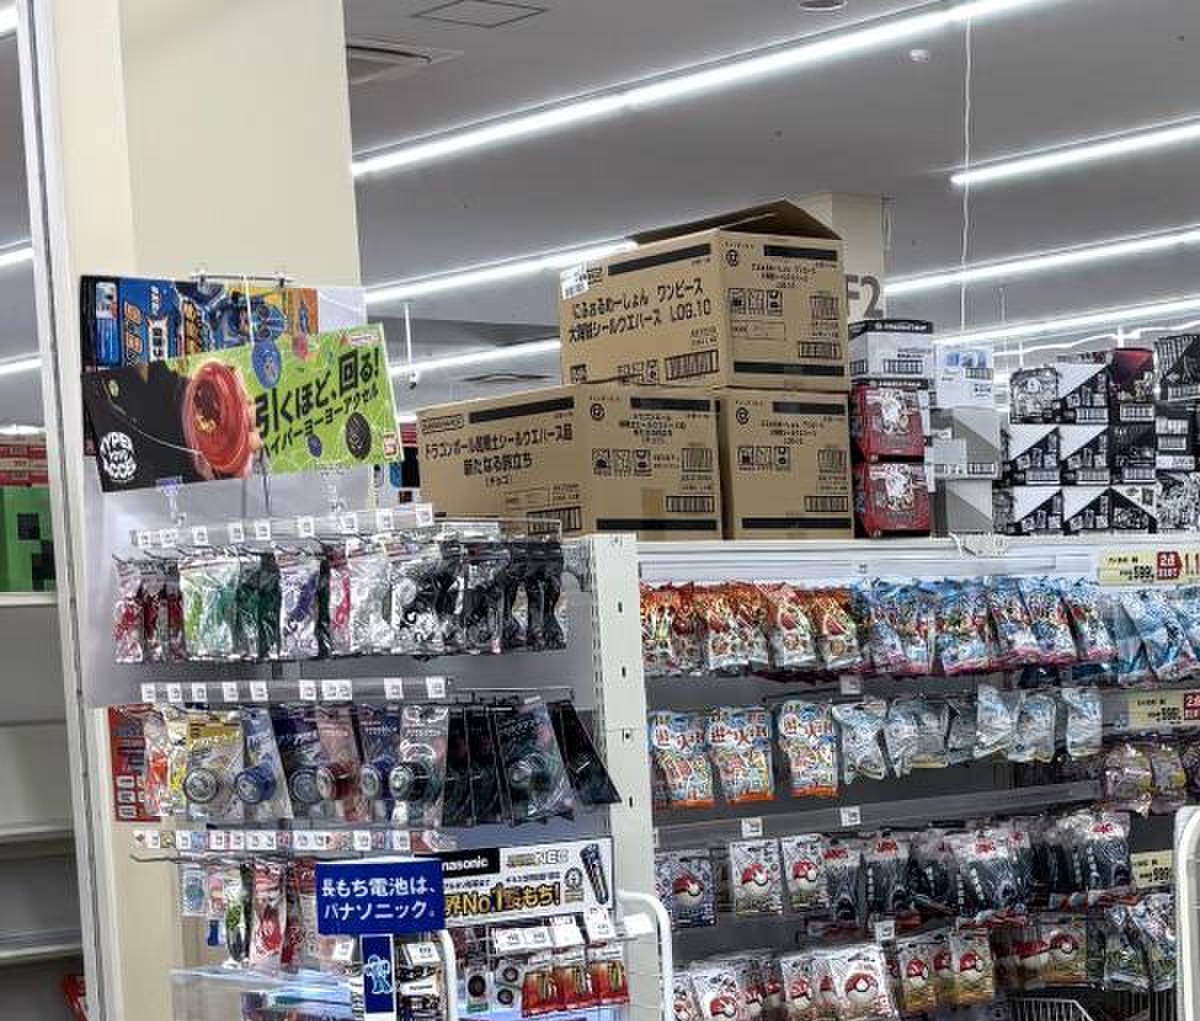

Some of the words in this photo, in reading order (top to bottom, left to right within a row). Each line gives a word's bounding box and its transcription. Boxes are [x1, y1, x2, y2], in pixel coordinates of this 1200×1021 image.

[656, 277, 704, 303] ワンピース
[442, 855, 489, 872] nasonic
[321, 877, 437, 898] 長もち電池は、
[324, 900, 435, 921] パナソニック。
